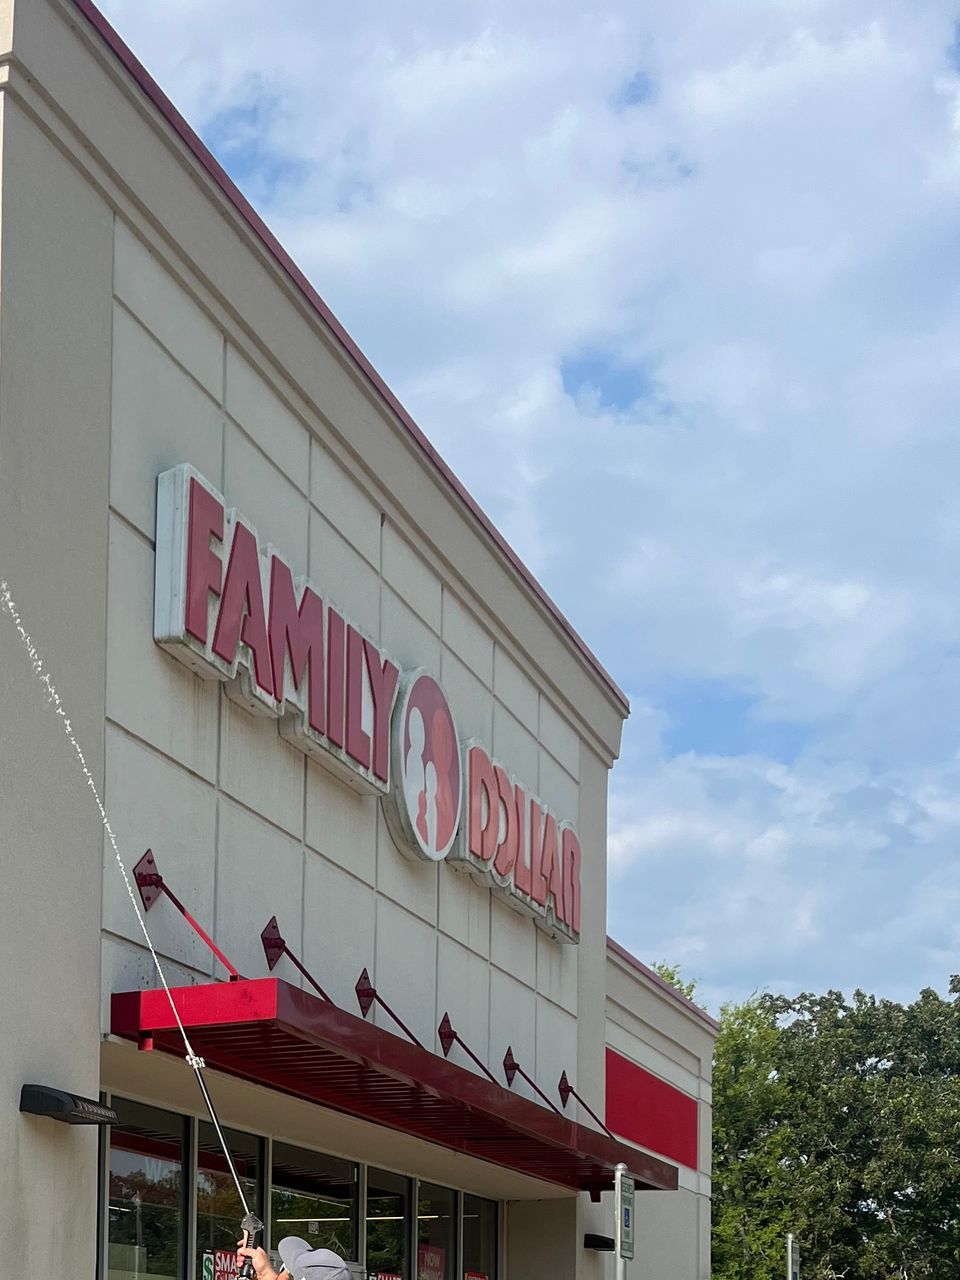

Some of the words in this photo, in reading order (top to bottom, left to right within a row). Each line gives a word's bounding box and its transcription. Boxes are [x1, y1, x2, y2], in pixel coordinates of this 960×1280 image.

[185, 476, 398, 782] FAMILY
[469, 746, 582, 935] DOLLAR
[215, 1252, 238, 1272] SMA
